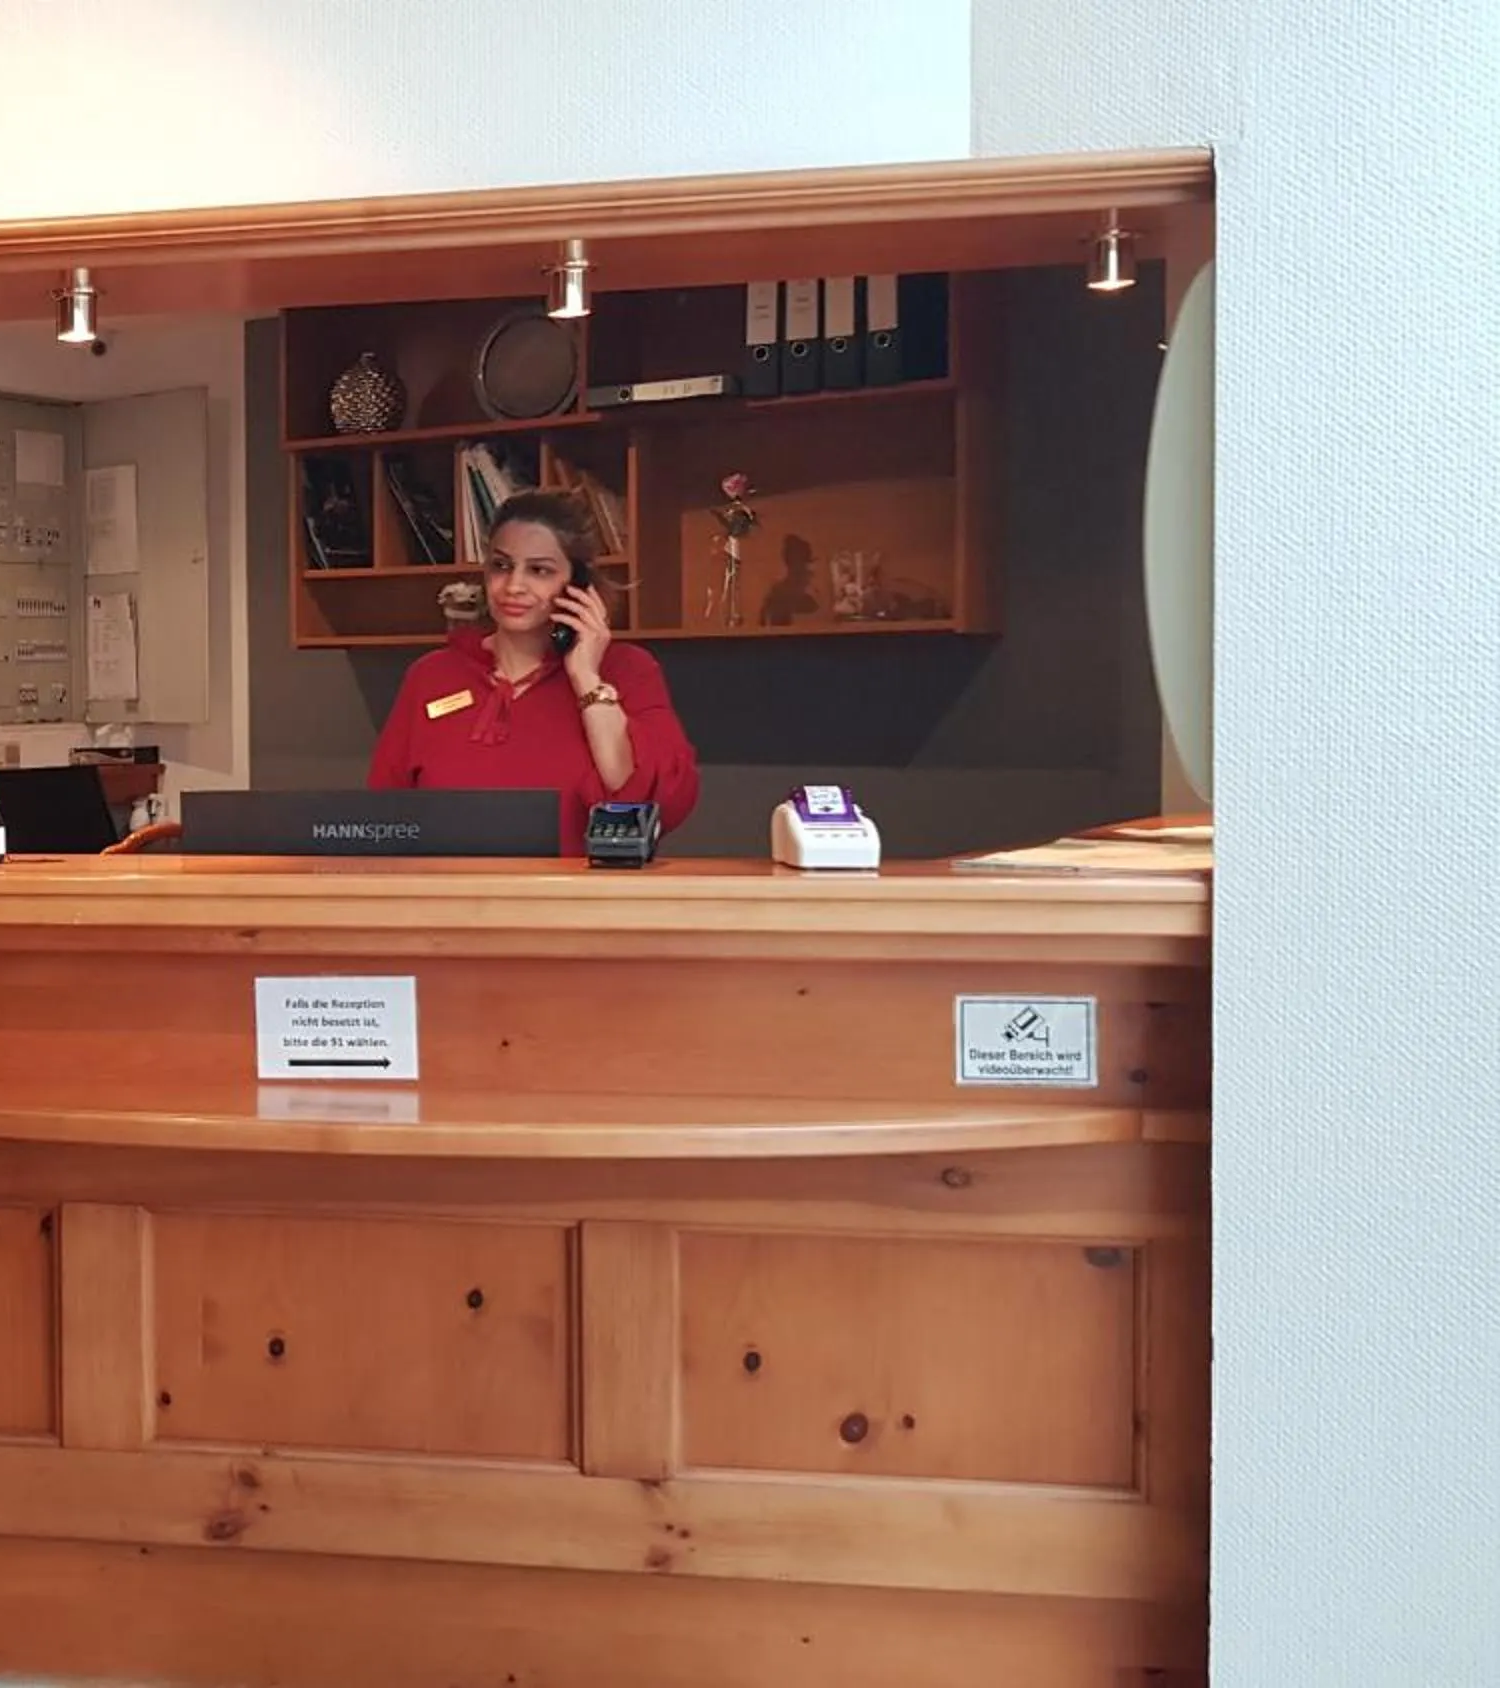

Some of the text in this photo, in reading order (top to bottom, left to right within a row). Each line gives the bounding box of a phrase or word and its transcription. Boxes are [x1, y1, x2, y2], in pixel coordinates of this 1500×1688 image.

[312, 822, 421, 842] HANNspree
[285, 998, 385, 1012] Falls die Rezeption
[292, 1016, 380, 1028] nicht besetzt ist,
[283, 1037, 308, 1047] bitte
[311, 1037, 327, 1047] die
[347, 1037, 388, 1047] wählen.
[969, 1049, 1082, 1061] Dieser Bereich wird
[978, 1064, 1074, 1075] videoüberwacht!
